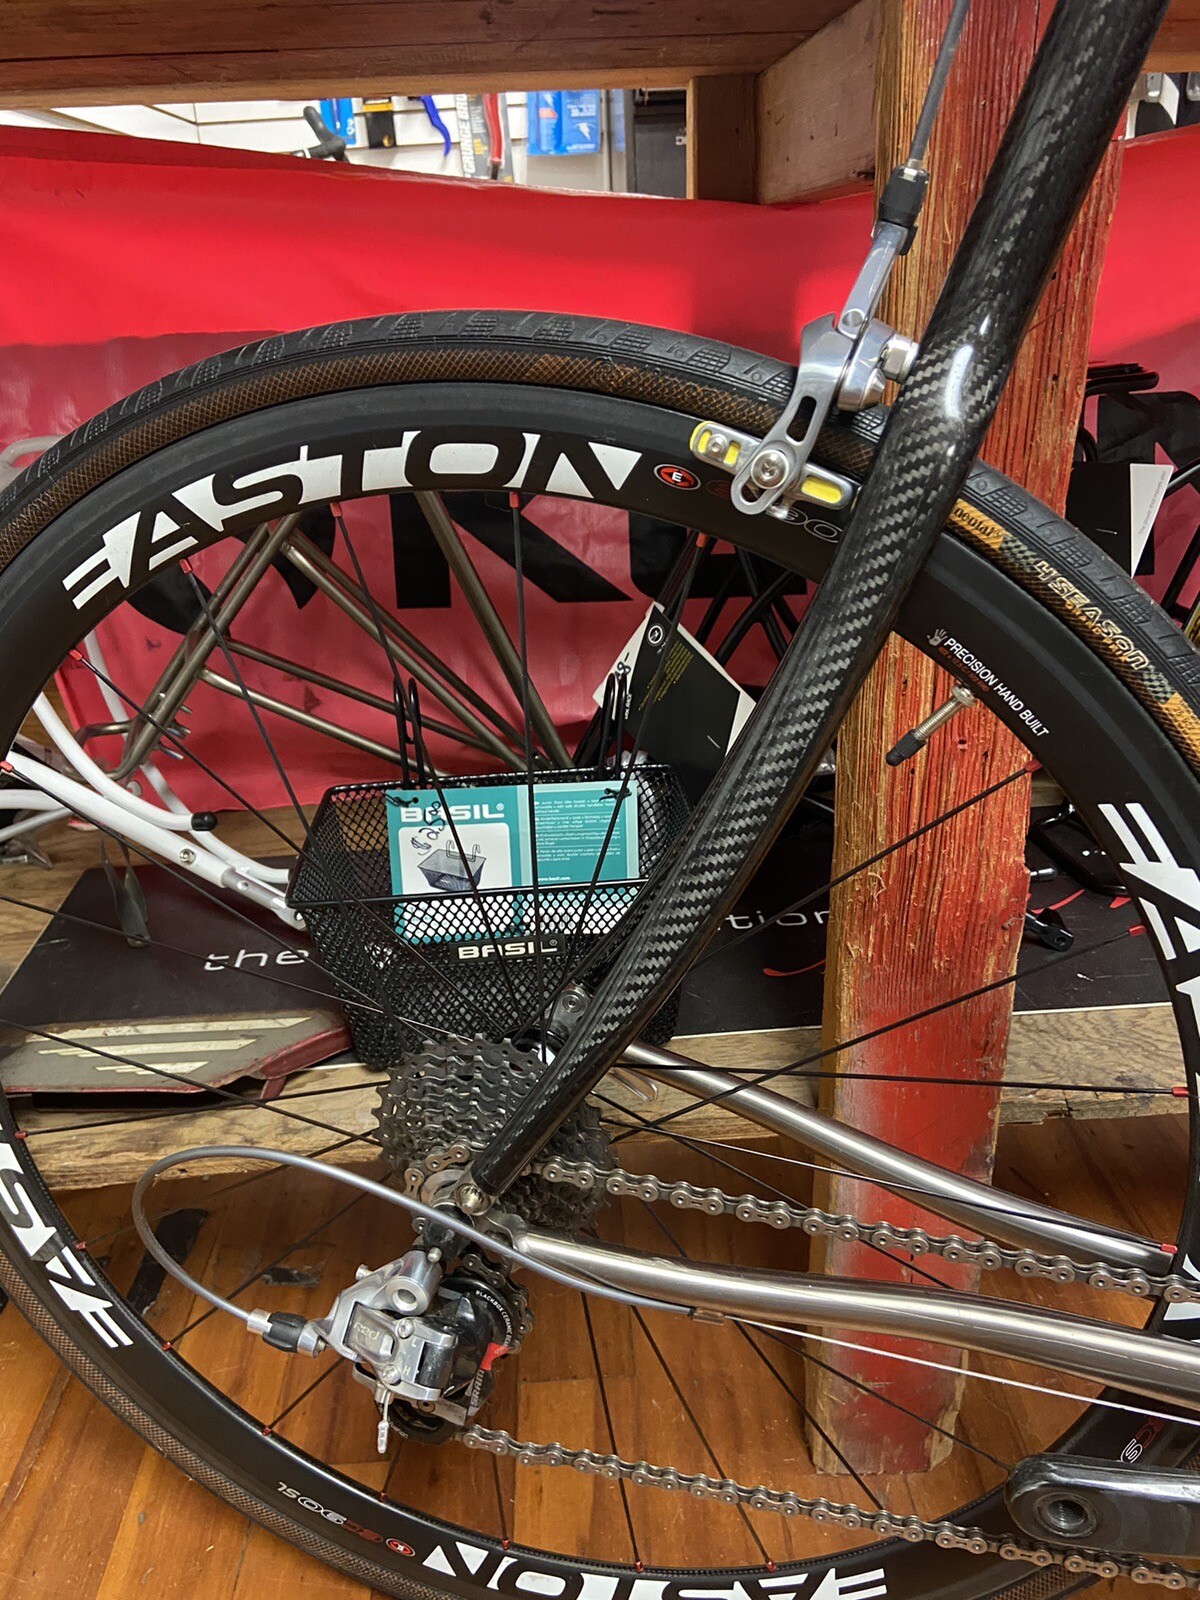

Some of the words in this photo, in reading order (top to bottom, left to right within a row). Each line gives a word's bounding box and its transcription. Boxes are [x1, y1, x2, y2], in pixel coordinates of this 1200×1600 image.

[63, 430, 642, 609] EASTON
[943, 637, 999, 686] PRECISION
[992, 682, 1024, 712] HAND
[1018, 708, 1050, 737] BUILT
[401, 804, 505, 822] BASIL
[204, 949, 309, 971] the
[458, 941, 558, 960] BASIL
[475, 1289, 504, 1312] BLACKBOX
[470, 1369, 485, 1407] SRAM
